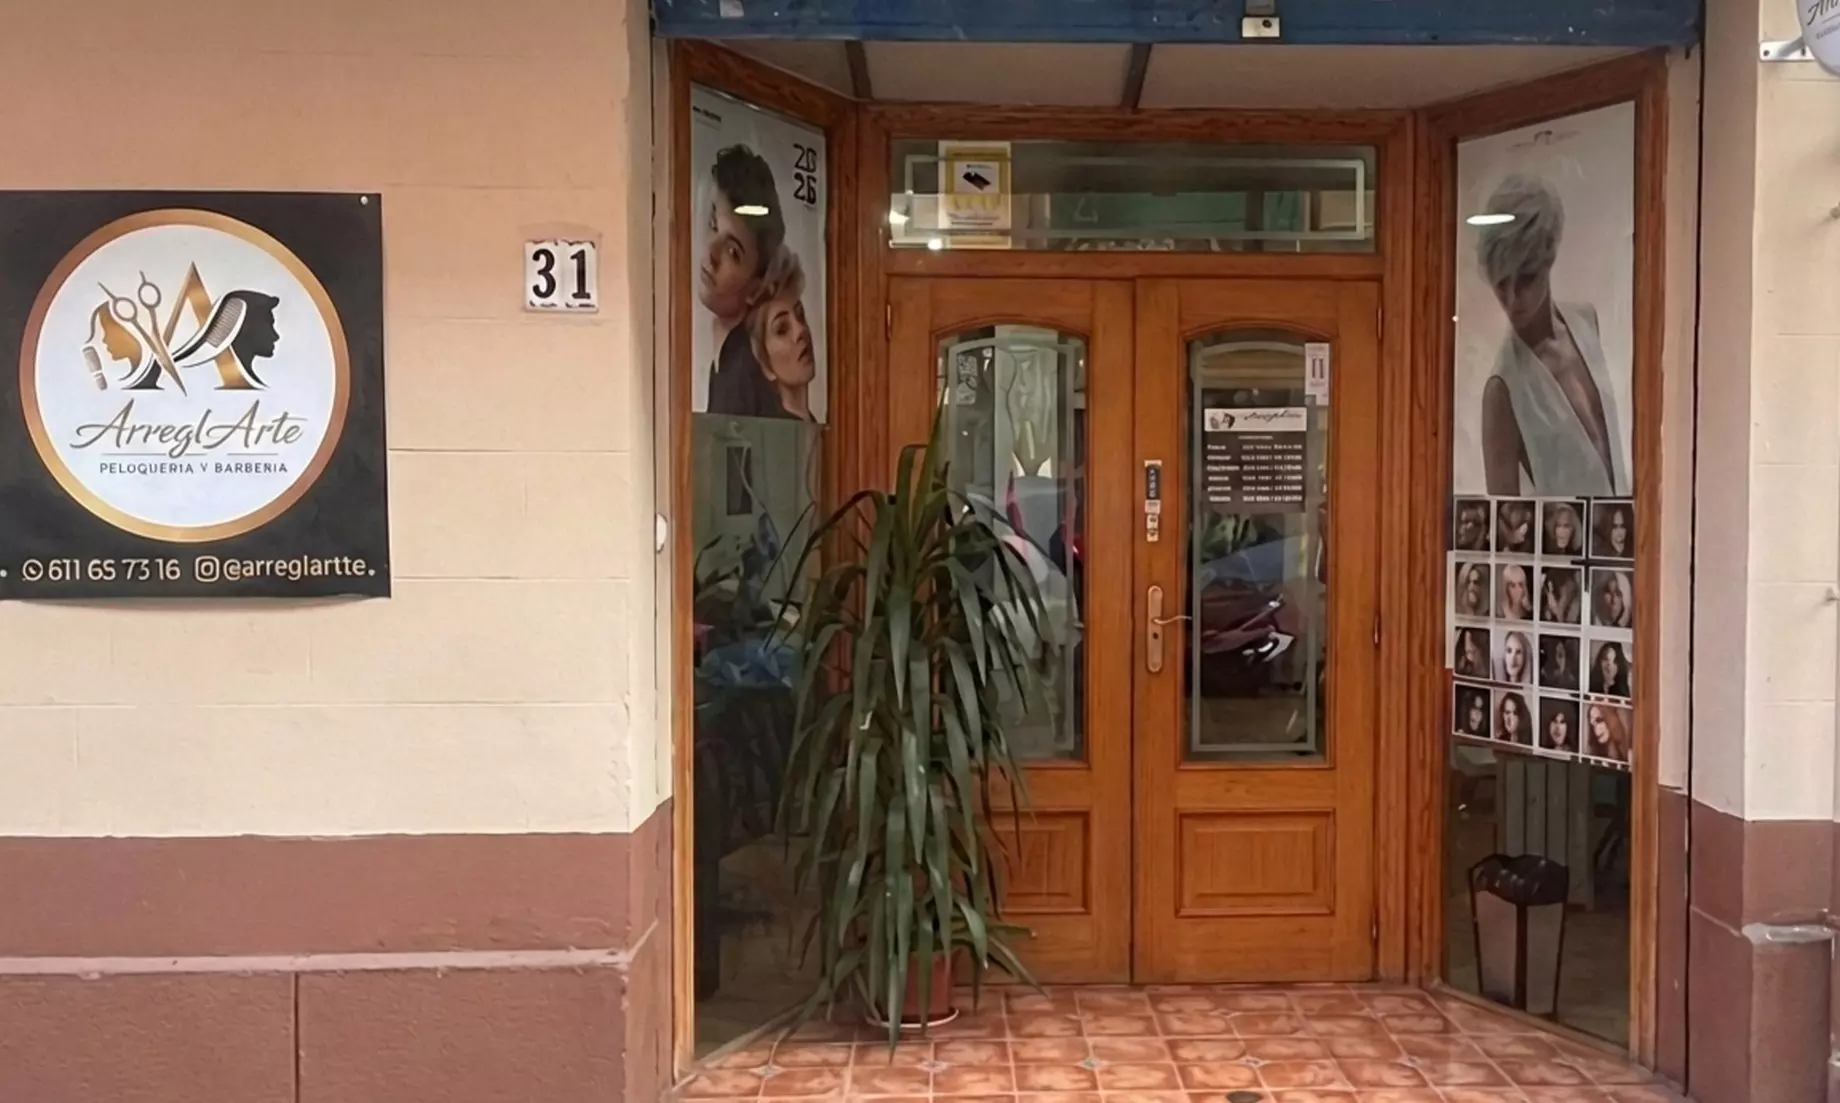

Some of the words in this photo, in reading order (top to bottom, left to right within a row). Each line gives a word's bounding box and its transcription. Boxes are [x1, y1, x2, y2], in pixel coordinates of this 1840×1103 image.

[532, 248, 591, 300] 31
[69, 397, 309, 459] ArreglArte
[48, 558, 80, 581] 611
[87, 558, 116, 581] 65
[121, 558, 150, 581] 73
[155, 558, 181, 581] 16
